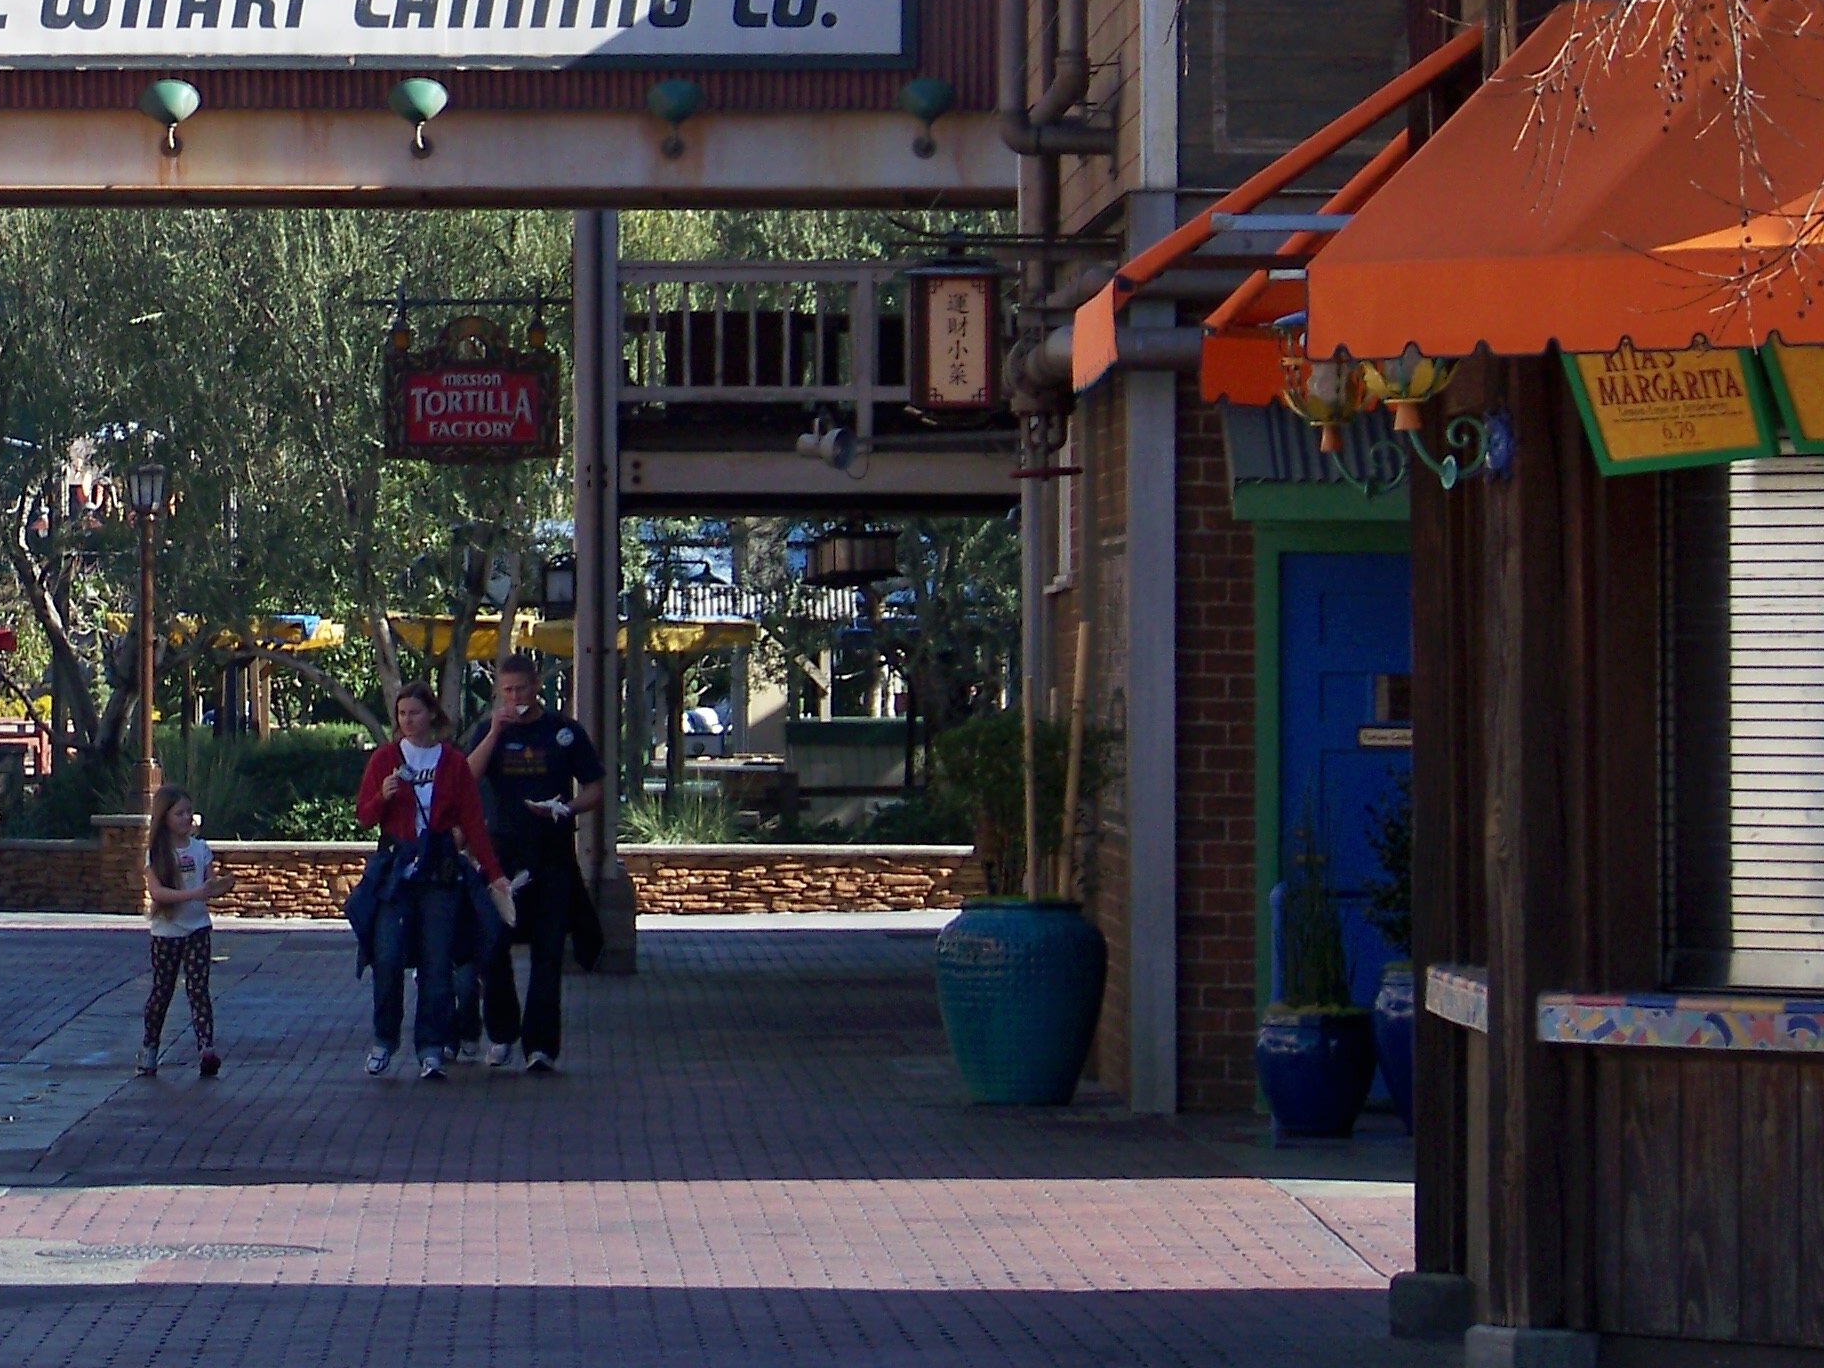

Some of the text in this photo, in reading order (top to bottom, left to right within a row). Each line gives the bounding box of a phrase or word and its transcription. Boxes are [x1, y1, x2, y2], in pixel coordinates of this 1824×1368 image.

[1597, 368, 1743, 406] MARGARITA
[411, 388, 532, 423] TORTILLA
[429, 421, 514, 437] FACTORY
